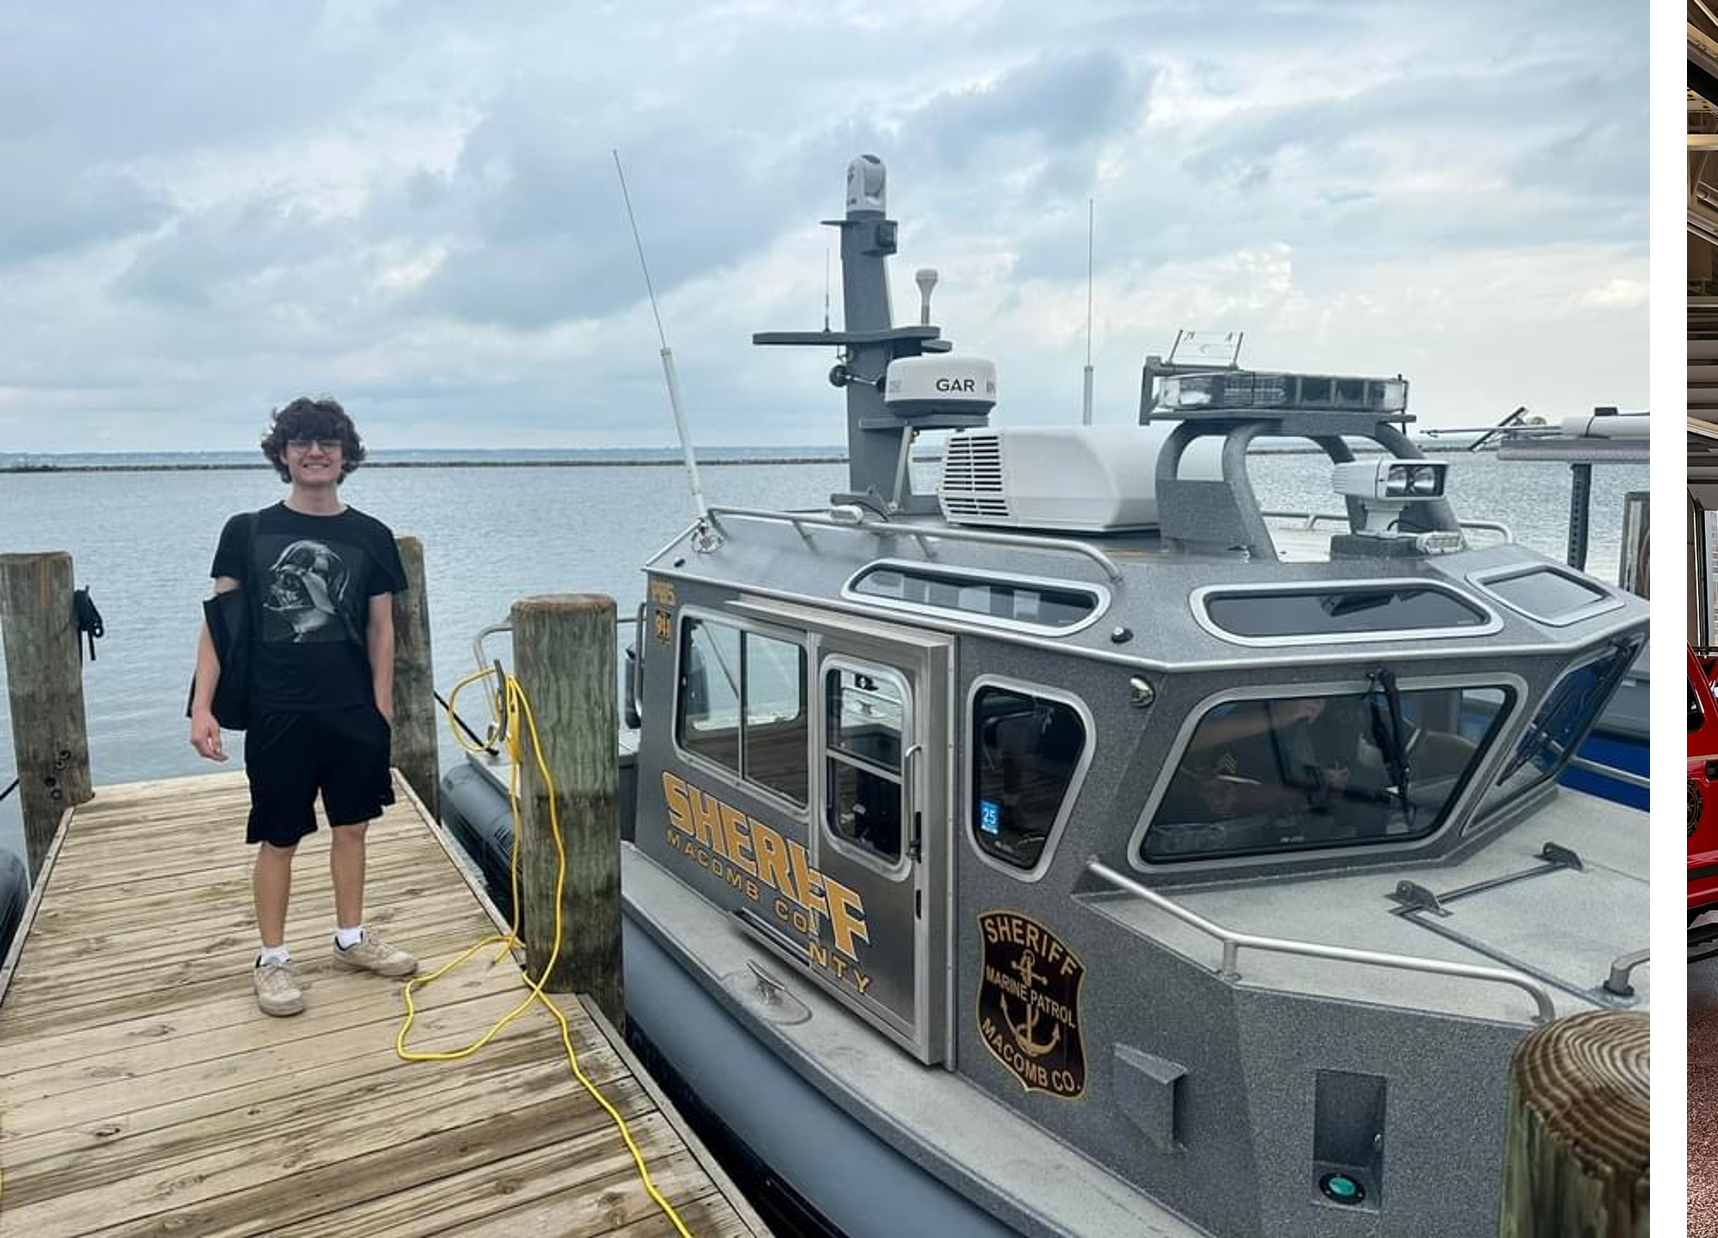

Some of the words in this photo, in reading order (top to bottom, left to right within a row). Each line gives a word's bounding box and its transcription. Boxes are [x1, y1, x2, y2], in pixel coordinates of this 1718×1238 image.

[666, 829, 760, 901] MACOMB
[774, 899, 872, 994] CONTY
[984, 916, 1078, 976] SHERIFF
[986, 964, 1028, 1000] MARINE
[1030, 989, 1076, 1029] PATROL
[982, 1017, 1048, 1086] MACOMB
[1051, 1070, 1081, 1093] CO.
